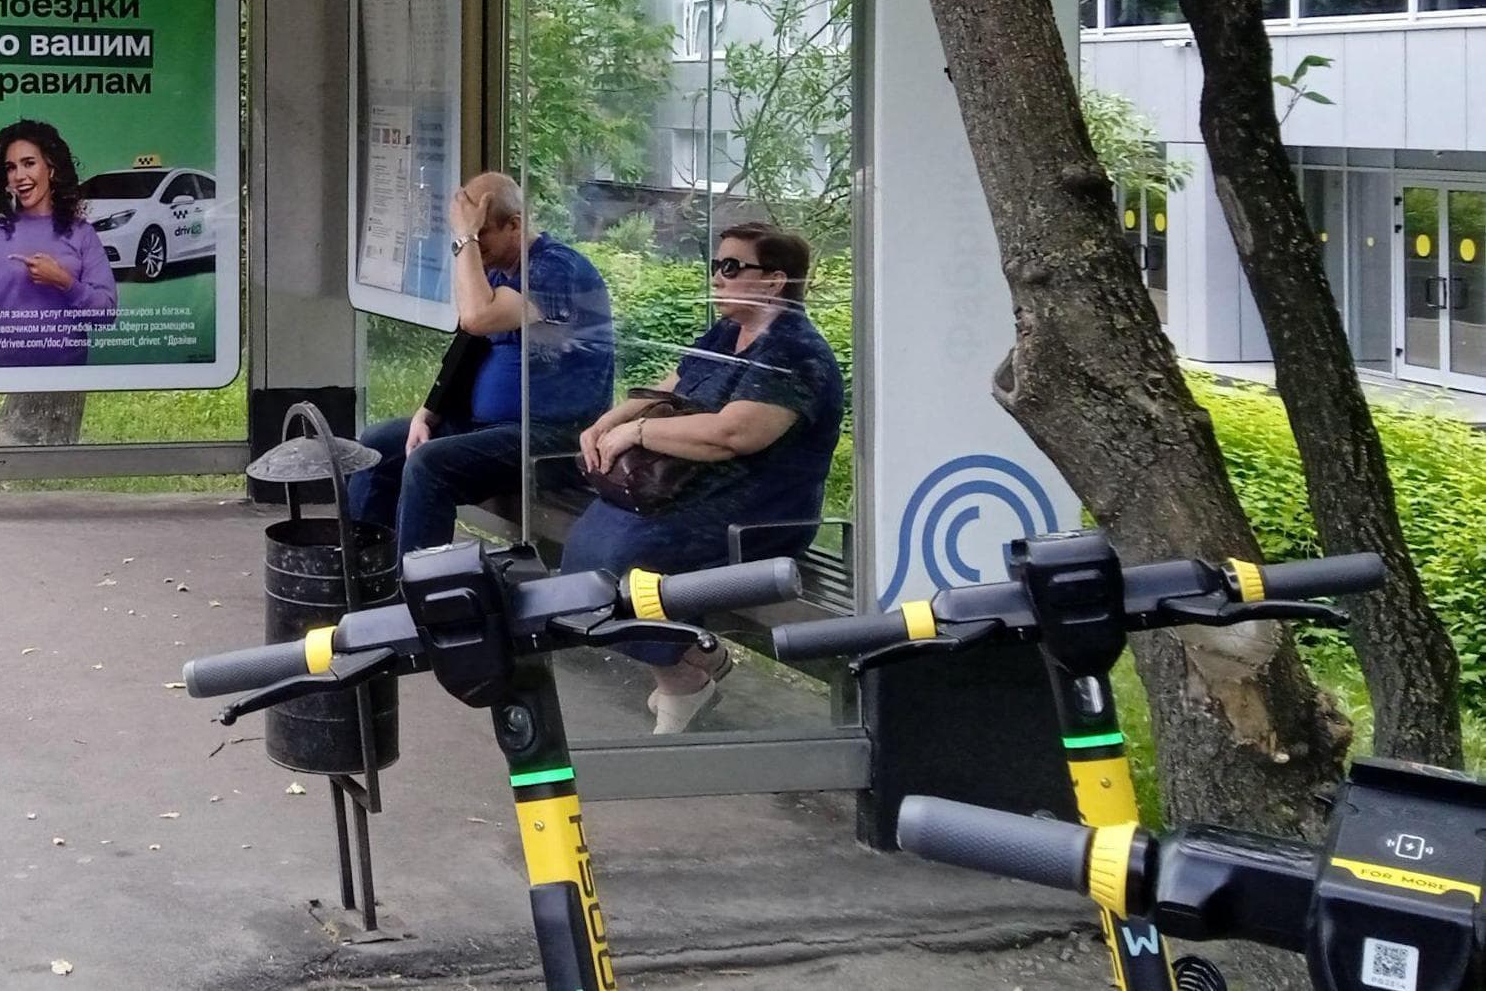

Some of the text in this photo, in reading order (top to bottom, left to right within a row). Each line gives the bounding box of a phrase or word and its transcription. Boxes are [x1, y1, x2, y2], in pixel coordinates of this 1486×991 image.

[30, 33, 151, 57] вашим
[12, 310, 38, 319] заказа
[40, 310, 61, 320] услуг
[63, 309, 104, 318] перевозки
[41, 325, 56, 333] или
[57, 322, 93, 334] службой
[119, 321, 149, 333] Оферта
[1360, 868, 1449, 891] FOR MORE
